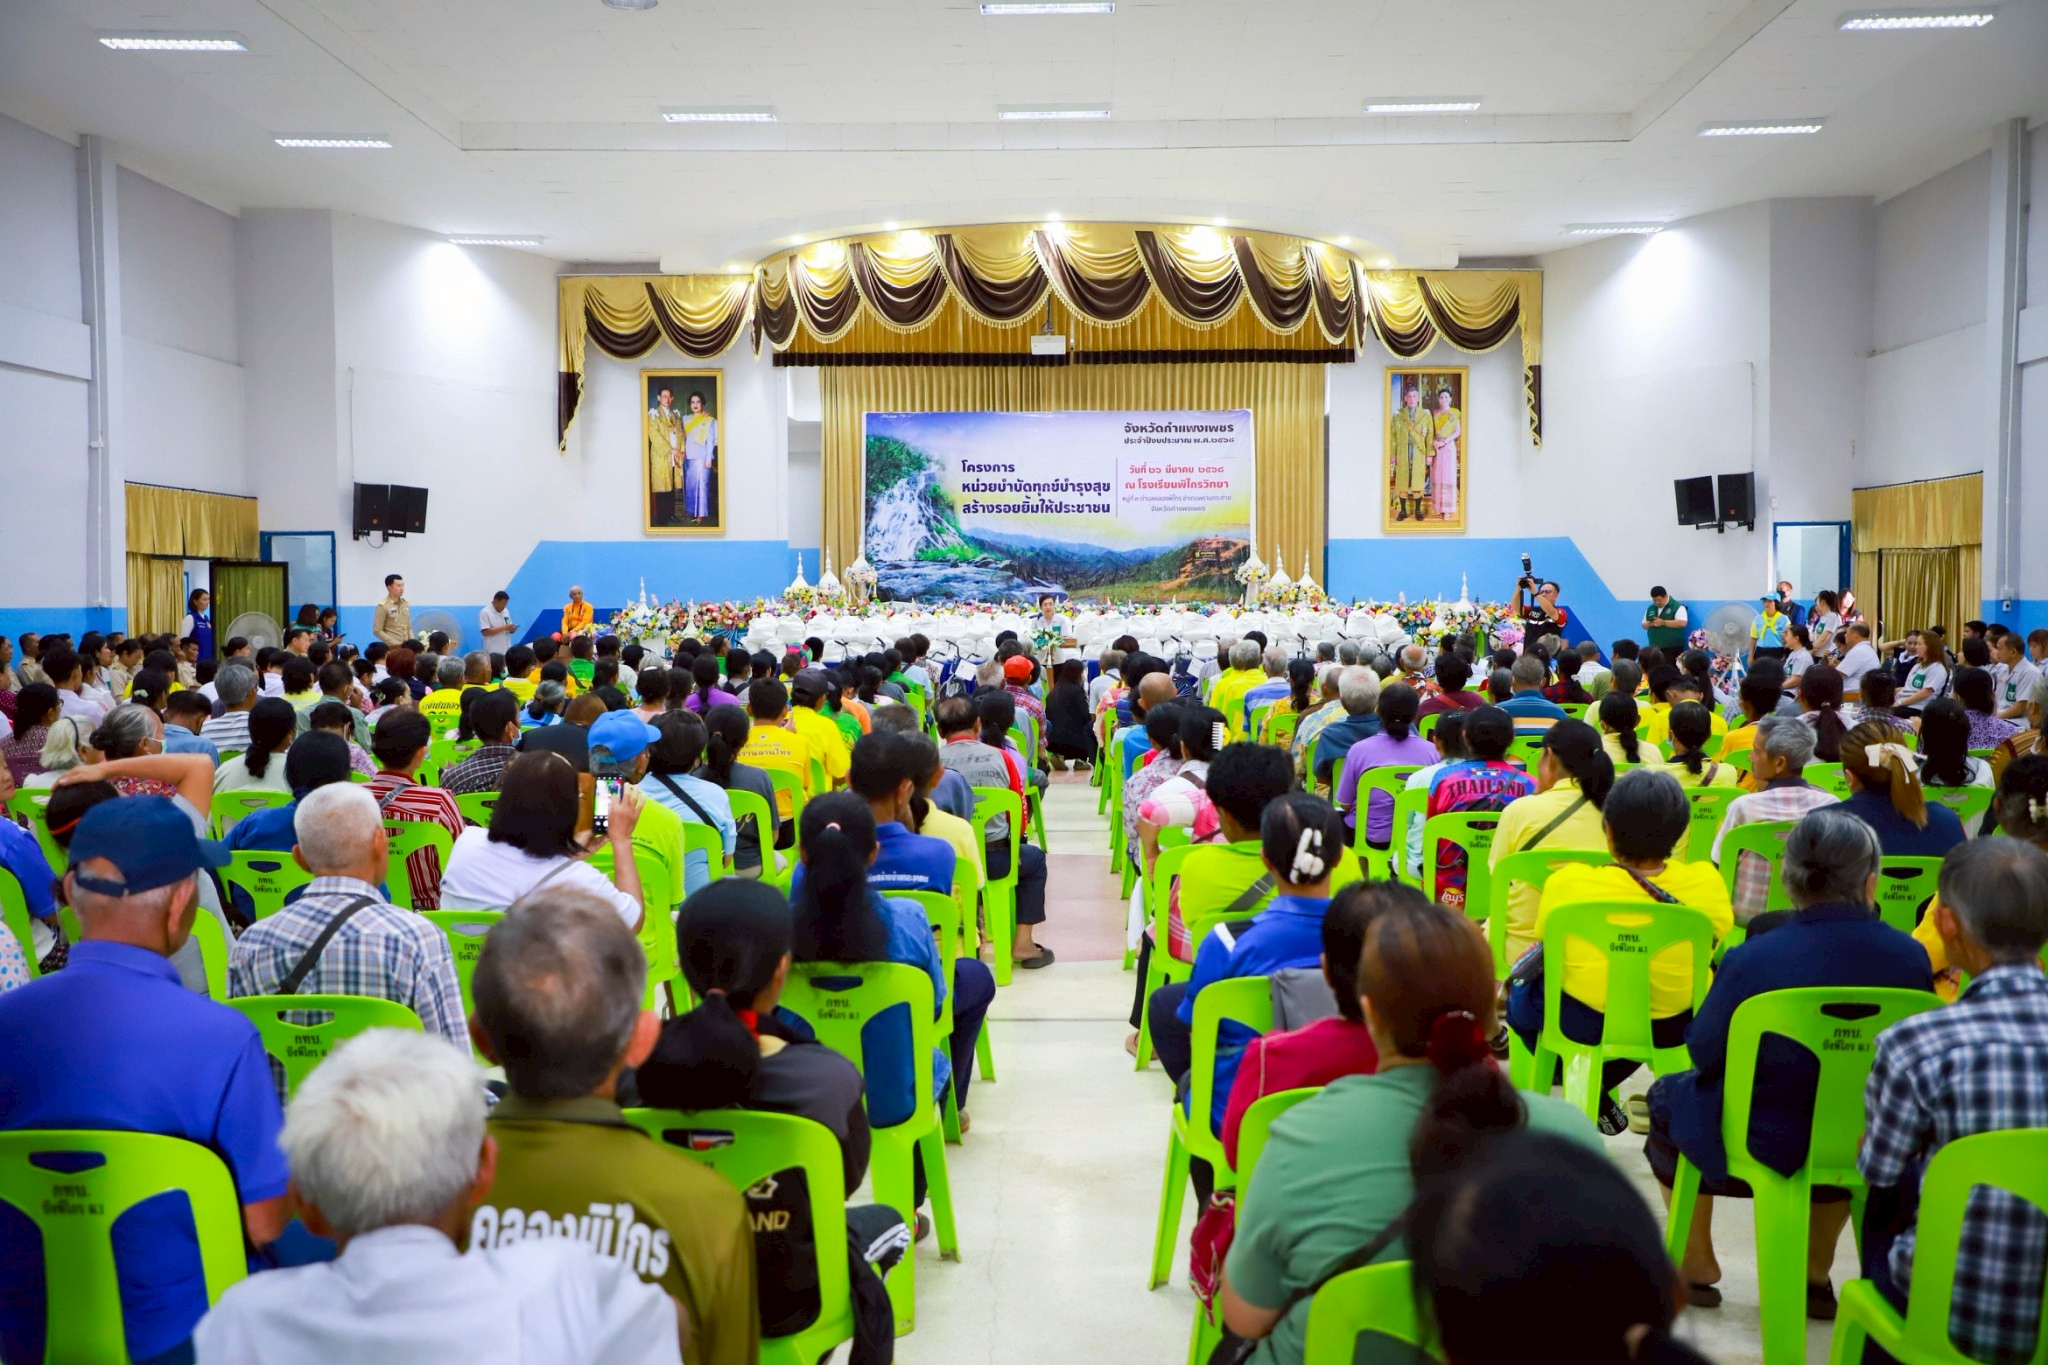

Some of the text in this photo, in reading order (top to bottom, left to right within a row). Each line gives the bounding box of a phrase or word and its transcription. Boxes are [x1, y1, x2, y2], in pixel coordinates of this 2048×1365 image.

[1124, 421, 1234, 433] จังหวัดกำแพงเพชร
[961, 459, 1016, 473] โครงการ
[1165, 464, 1195, 474] มีนาคม
[961, 478, 1111, 497] หน่วยบำบัดทุกข์บำรุงสุข
[1138, 478, 1229, 490] โรงเรียนพิไกรวิทยา
[962, 495, 1111, 514] สร้างรอยยิ้มให้ประชาชน
[1447, 778, 1526, 799] THAILAND
